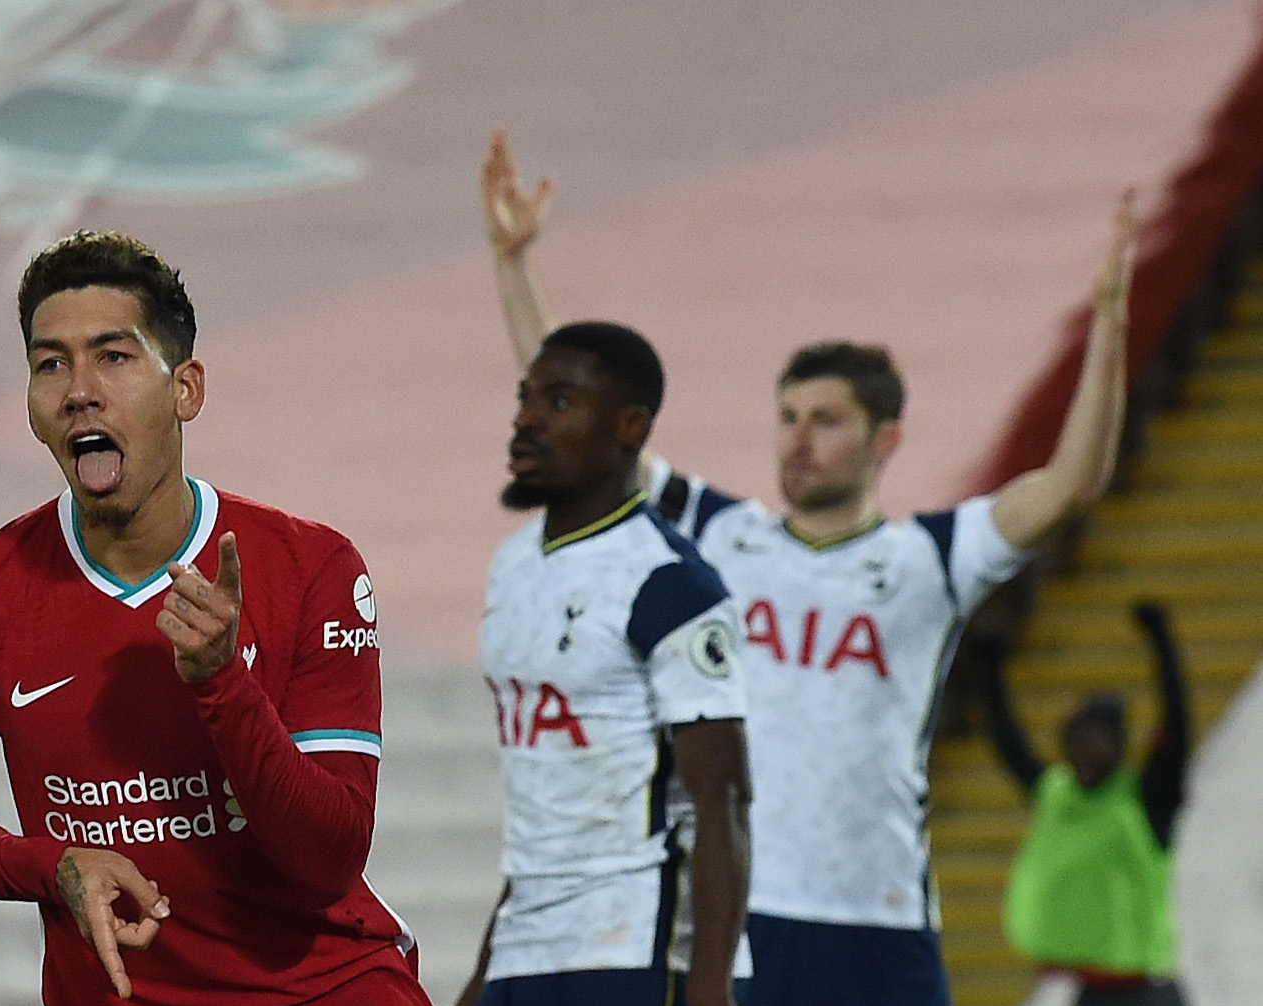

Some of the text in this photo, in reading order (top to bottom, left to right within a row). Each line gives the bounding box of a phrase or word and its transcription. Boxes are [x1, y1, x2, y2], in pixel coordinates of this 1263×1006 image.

[745, 599, 888, 677] AIA
[44, 770, 209, 806] Standard
[44, 804, 217, 846] Chartered
